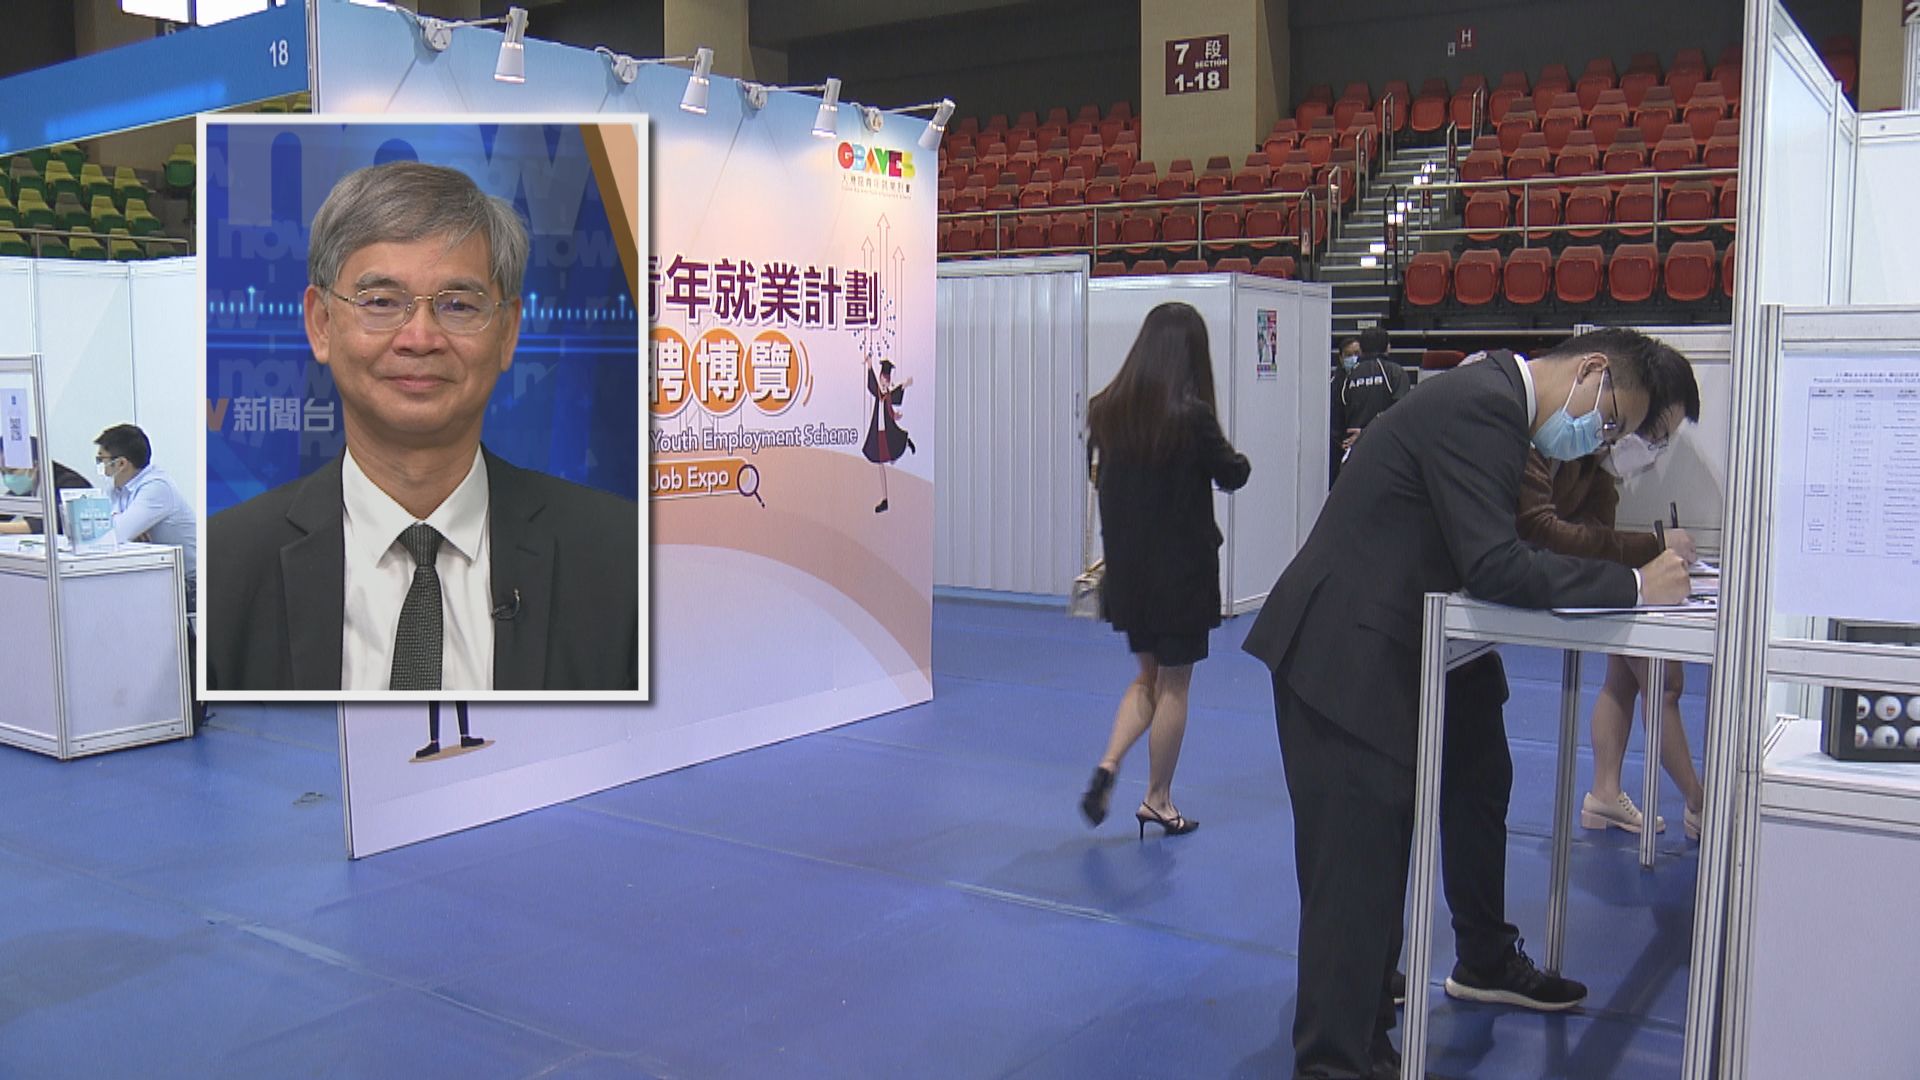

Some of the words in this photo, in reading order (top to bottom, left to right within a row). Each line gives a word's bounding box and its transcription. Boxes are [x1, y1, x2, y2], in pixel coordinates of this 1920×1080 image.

[269, 39, 289, 67] 18
[1174, 42, 1190, 65] 7
[1205, 40, 1222, 60] 段
[1194, 58, 1228, 69] SECTION
[1174, 71, 1220, 92] 1-18
[838, 142, 915, 178] GBAVES
[233, 397, 335, 433] 新聞台
[651, 426, 698, 452] Youth
[703, 425, 801, 455] Employment
[804, 423, 858, 447] Scheme
[652, 466, 682, 492] Job
[688, 466, 729, 493] Expo
